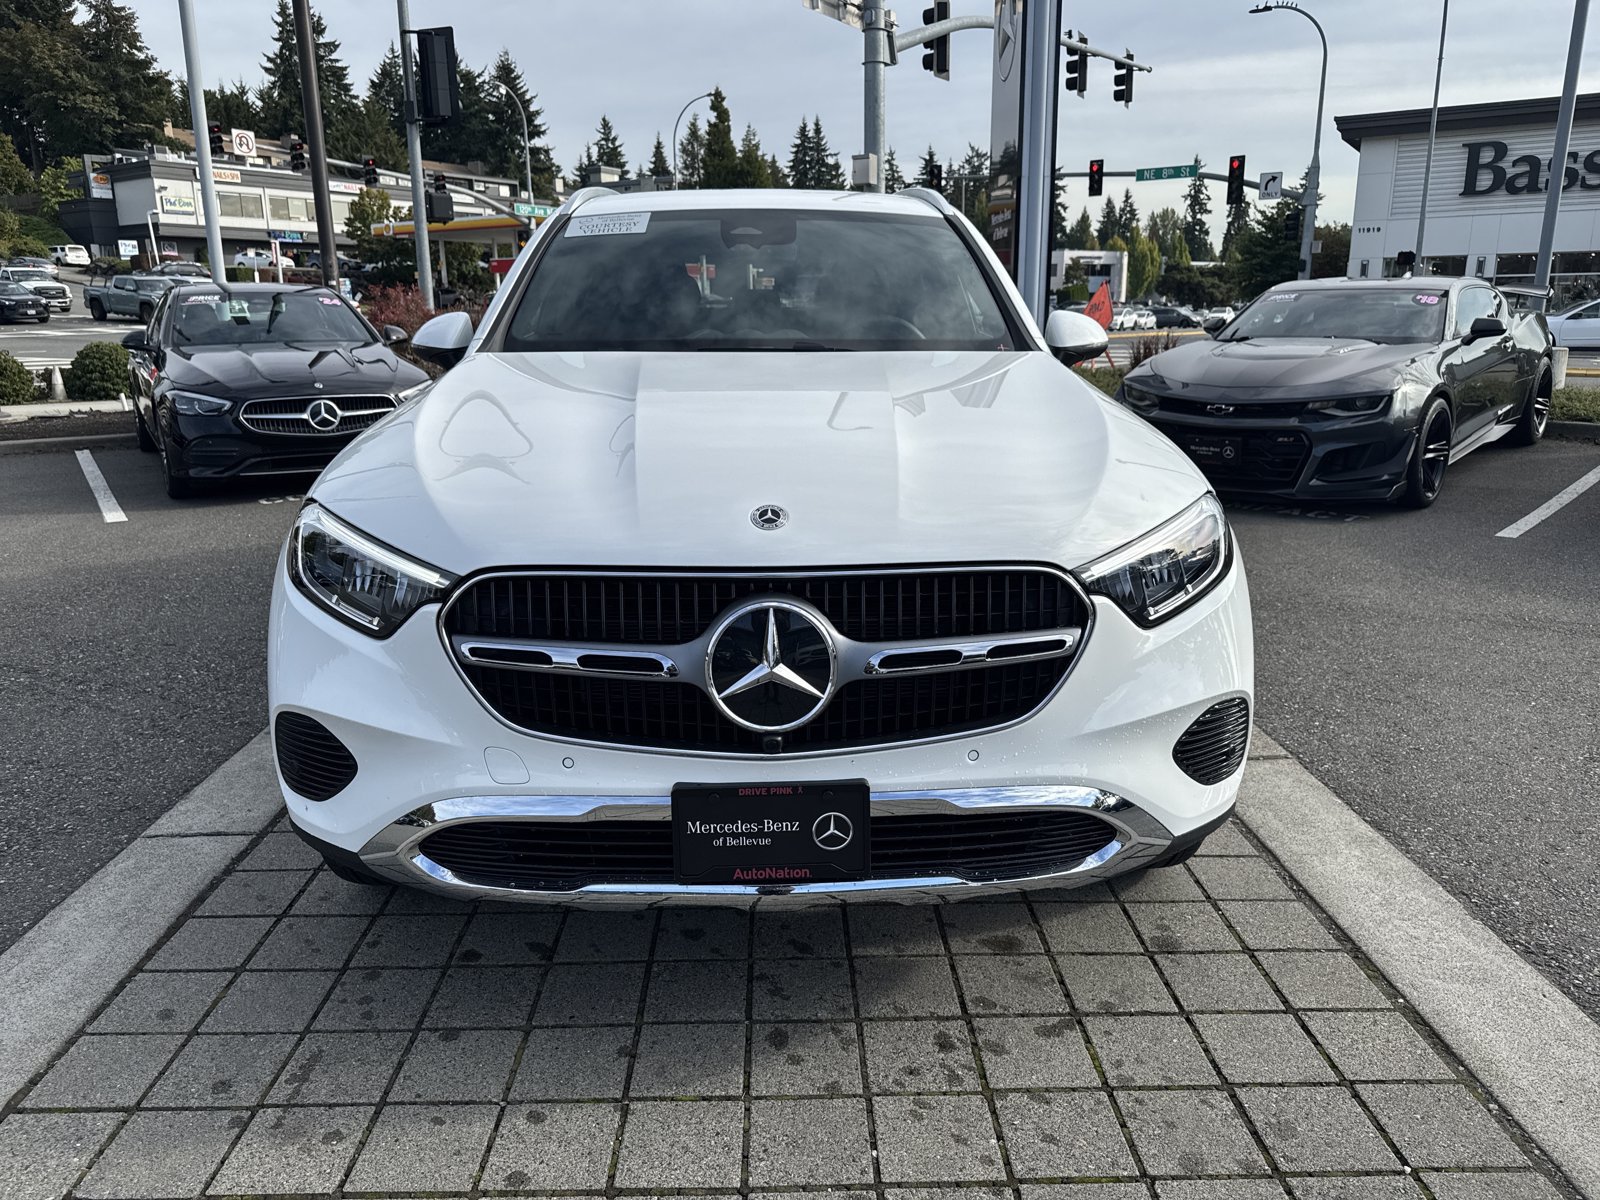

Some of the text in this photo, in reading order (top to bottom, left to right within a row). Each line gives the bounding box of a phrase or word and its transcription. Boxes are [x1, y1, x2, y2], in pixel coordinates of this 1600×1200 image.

[1143, 166, 1190, 180] NE 8th St
[519, 205, 532, 215] 120th
[534, 207, 546, 217] Ave
[580, 221, 639, 230] COURTESY
[583, 227, 633, 235] VEHICLE
[738, 787, 793, 796] DRIVE PINK
[687, 819, 800, 834] Mercedes-Benz
[713, 836, 772, 847] of Bellevue
[733, 867, 810, 880] AutoNation
